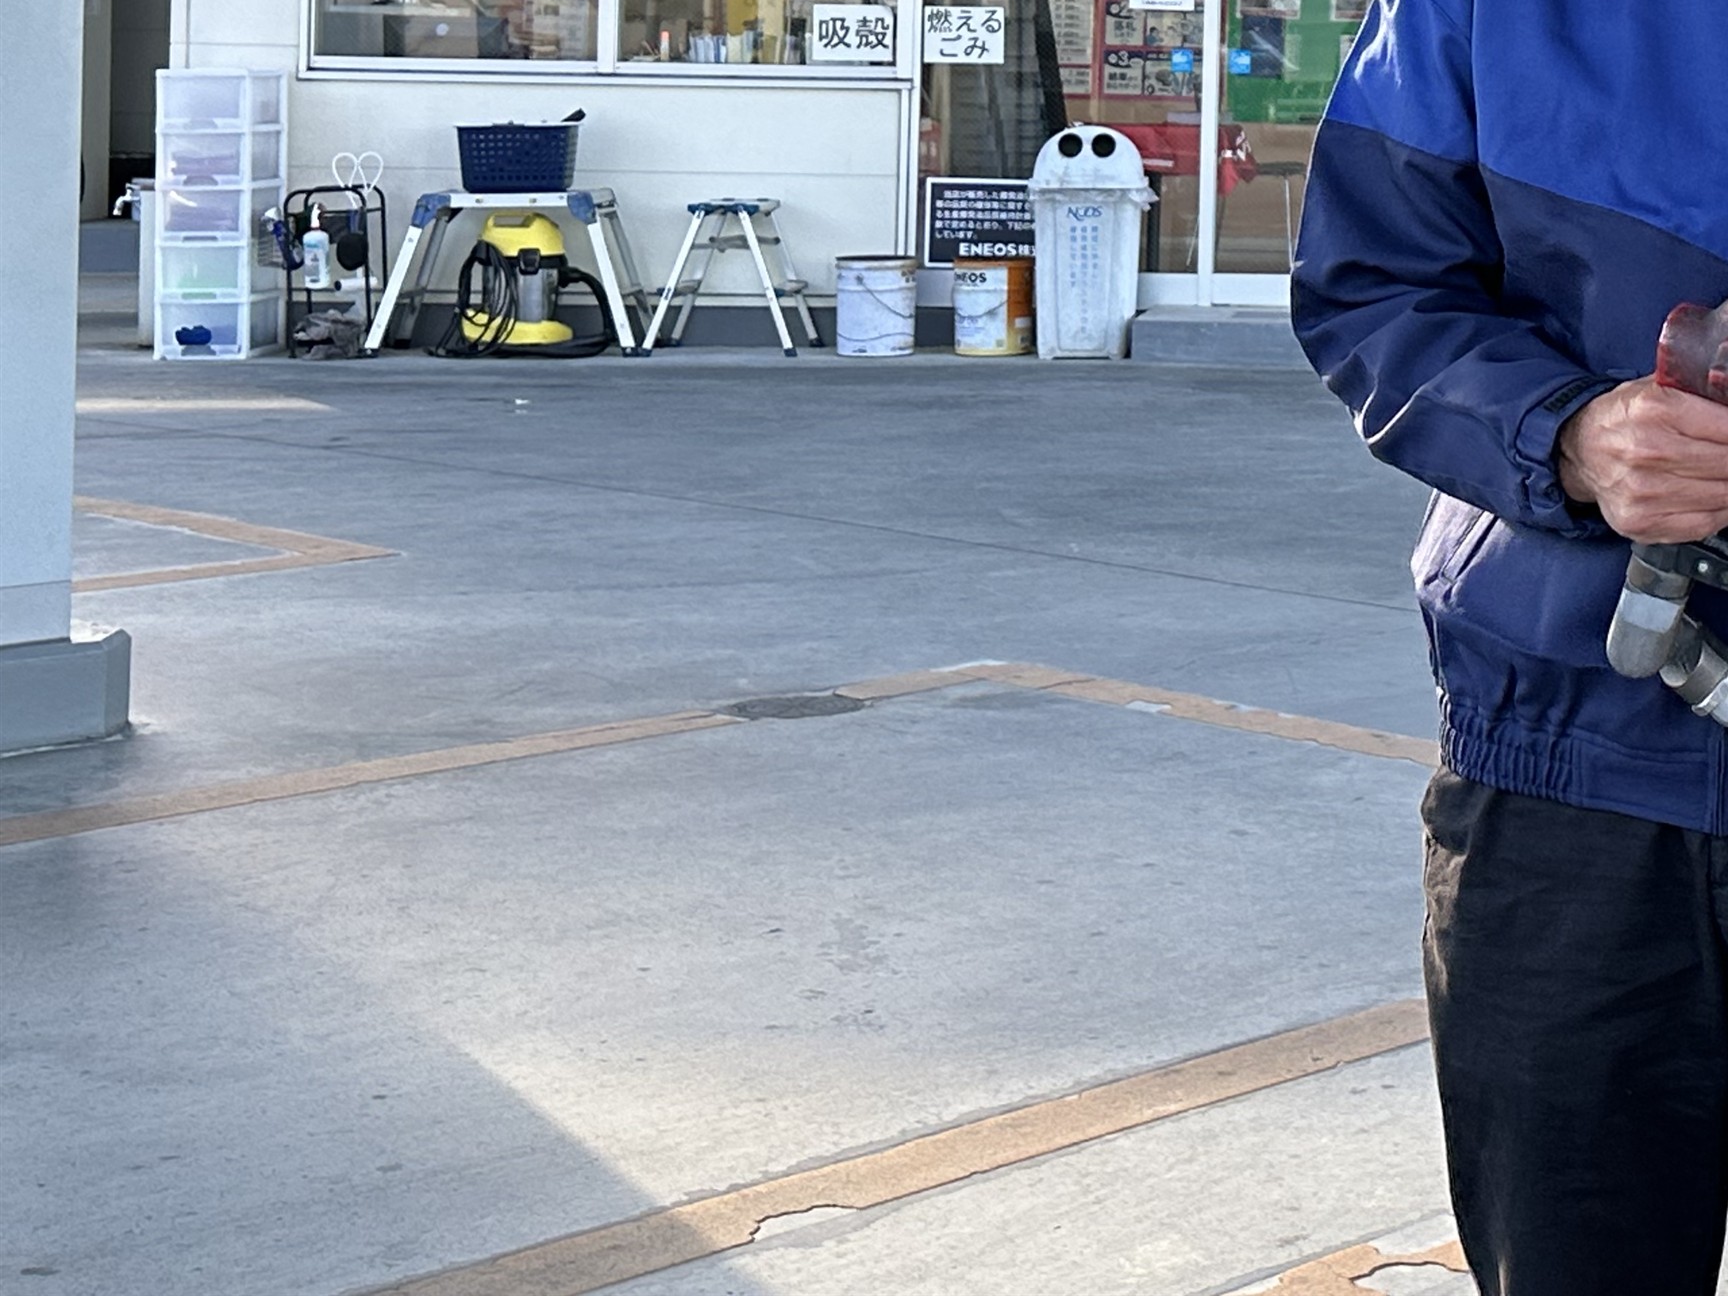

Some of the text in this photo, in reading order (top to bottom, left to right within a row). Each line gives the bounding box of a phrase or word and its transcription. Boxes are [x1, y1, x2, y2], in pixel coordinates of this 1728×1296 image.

[818, 15, 890, 50] 吸殻
[927, 8, 1003, 34] 燃える
[939, 36, 990, 59] ごみ
